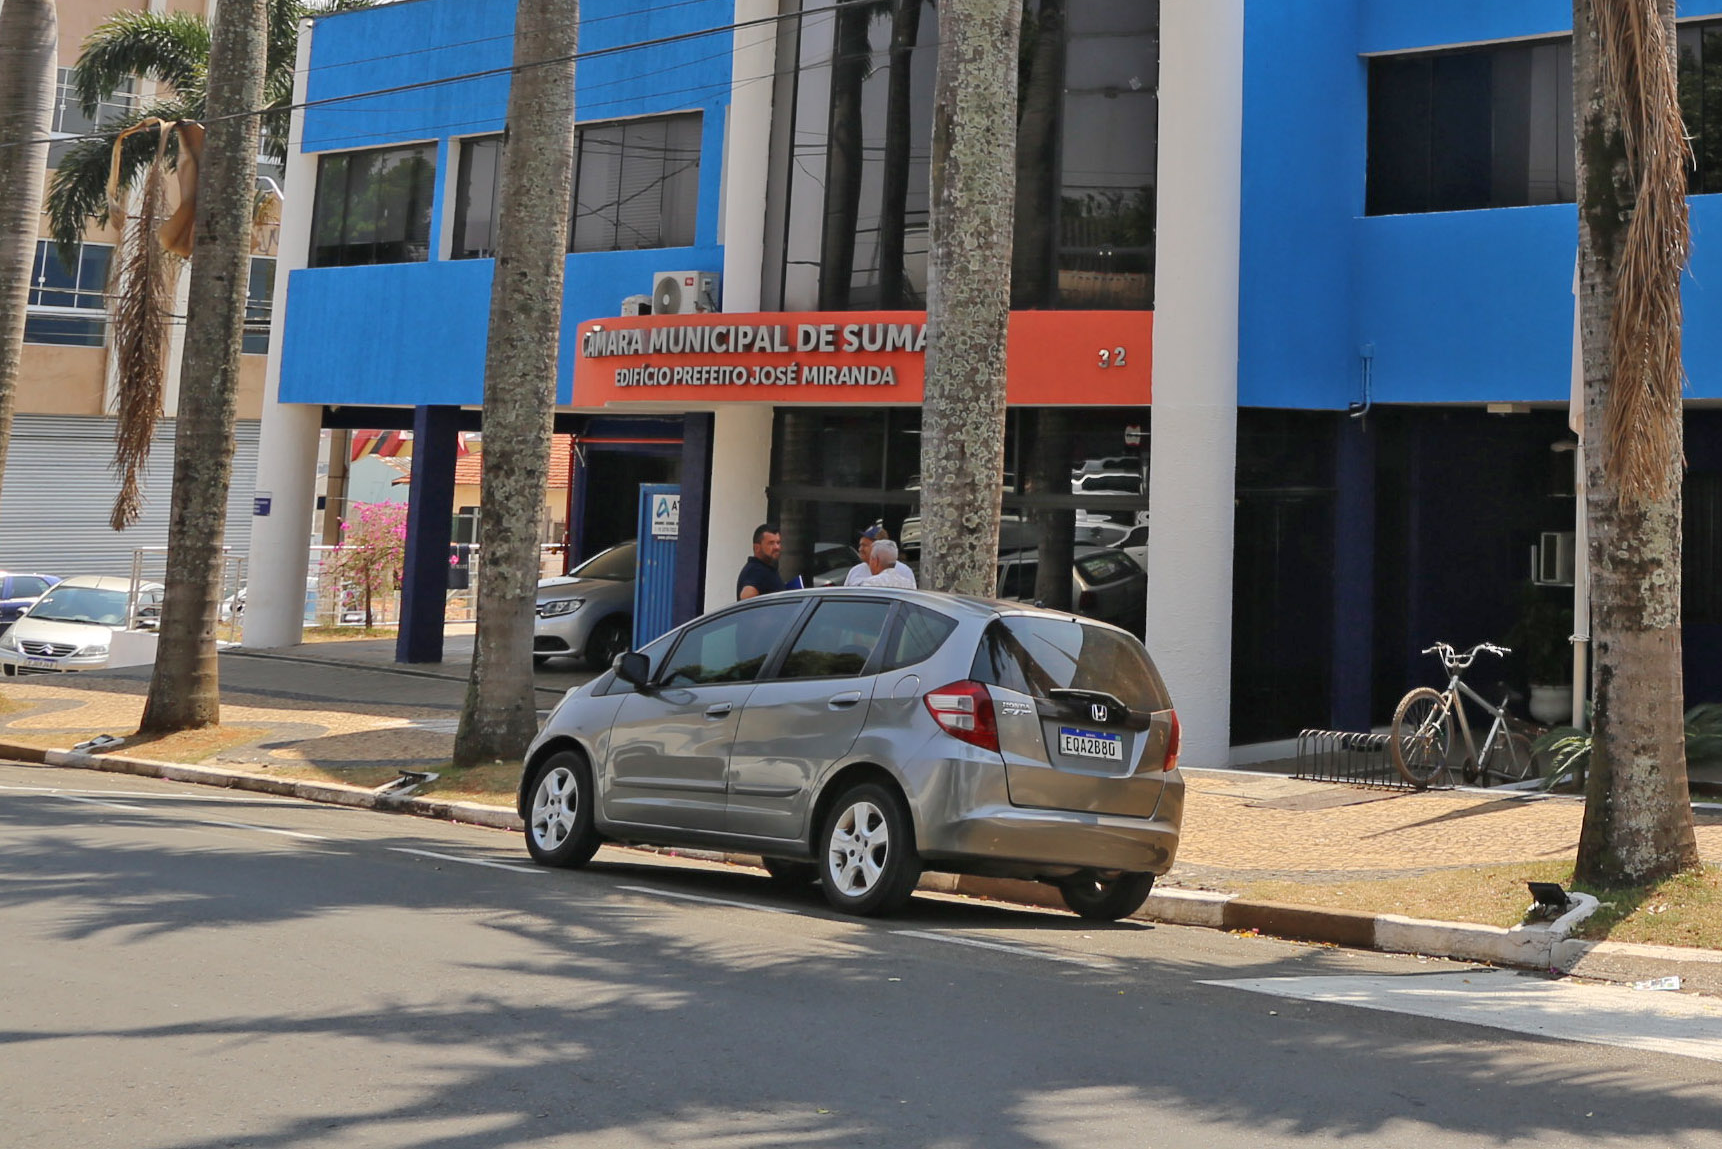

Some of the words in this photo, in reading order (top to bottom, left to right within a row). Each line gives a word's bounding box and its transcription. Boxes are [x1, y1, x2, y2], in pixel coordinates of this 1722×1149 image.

[648, 325, 789, 355] MUNICIPAL
[797, 324, 836, 353] DE
[842, 323, 927, 353] SUMA
[614, 364, 671, 387] EDIFÍCIO
[673, 366, 748, 386] PREFEITO
[750, 363, 797, 386] JOSÉ
[802, 366, 896, 386] MIRANDA
